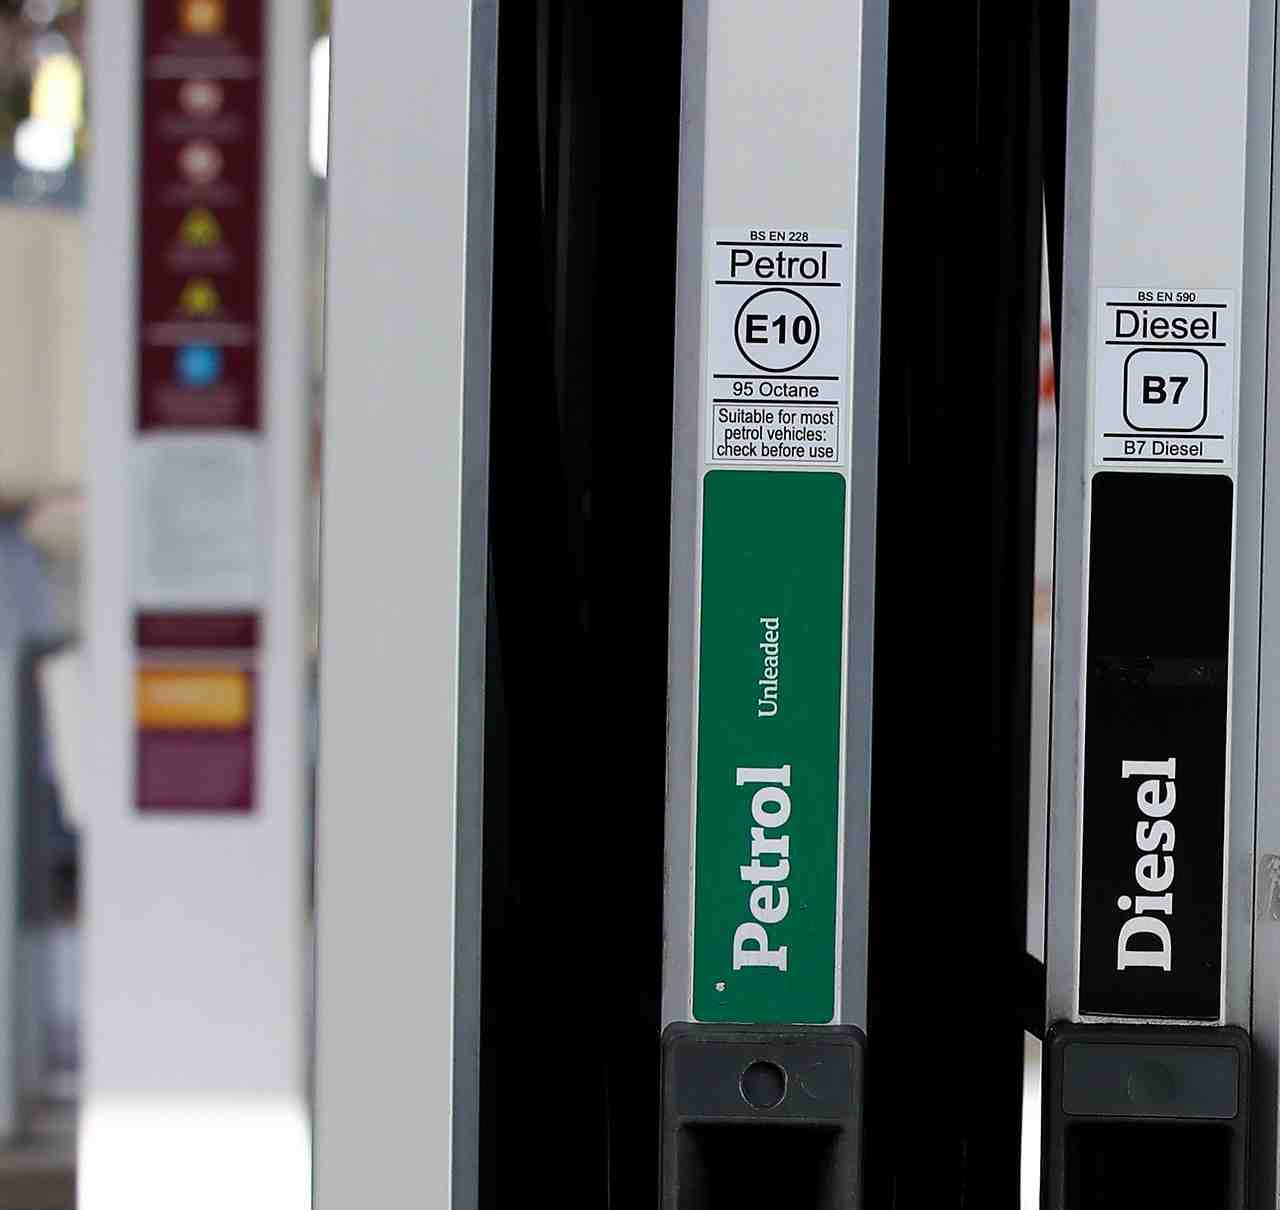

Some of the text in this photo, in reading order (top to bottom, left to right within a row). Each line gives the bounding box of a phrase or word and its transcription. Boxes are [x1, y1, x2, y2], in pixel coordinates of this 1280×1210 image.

[750, 231, 809, 242] BS EN 228
[730, 249, 827, 279] Petrol
[1138, 292, 1196, 302] BS EN 590
[745, 314, 812, 345] E10
[1115, 310, 1217, 339] Diesel
[733, 382, 819, 397] 95 Octane
[1142, 376, 1189, 405] B7
[718, 408, 834, 425] Suitable for most
[724, 426, 827, 444] petrol vehicles:
[716, 442, 834, 458] check before use
[1124, 441, 1203, 456] B7 Diesel
[758, 616, 780, 719] Unleaded
[732, 764, 792, 972] Petrol
[1116, 757, 1176, 972] Diesel
